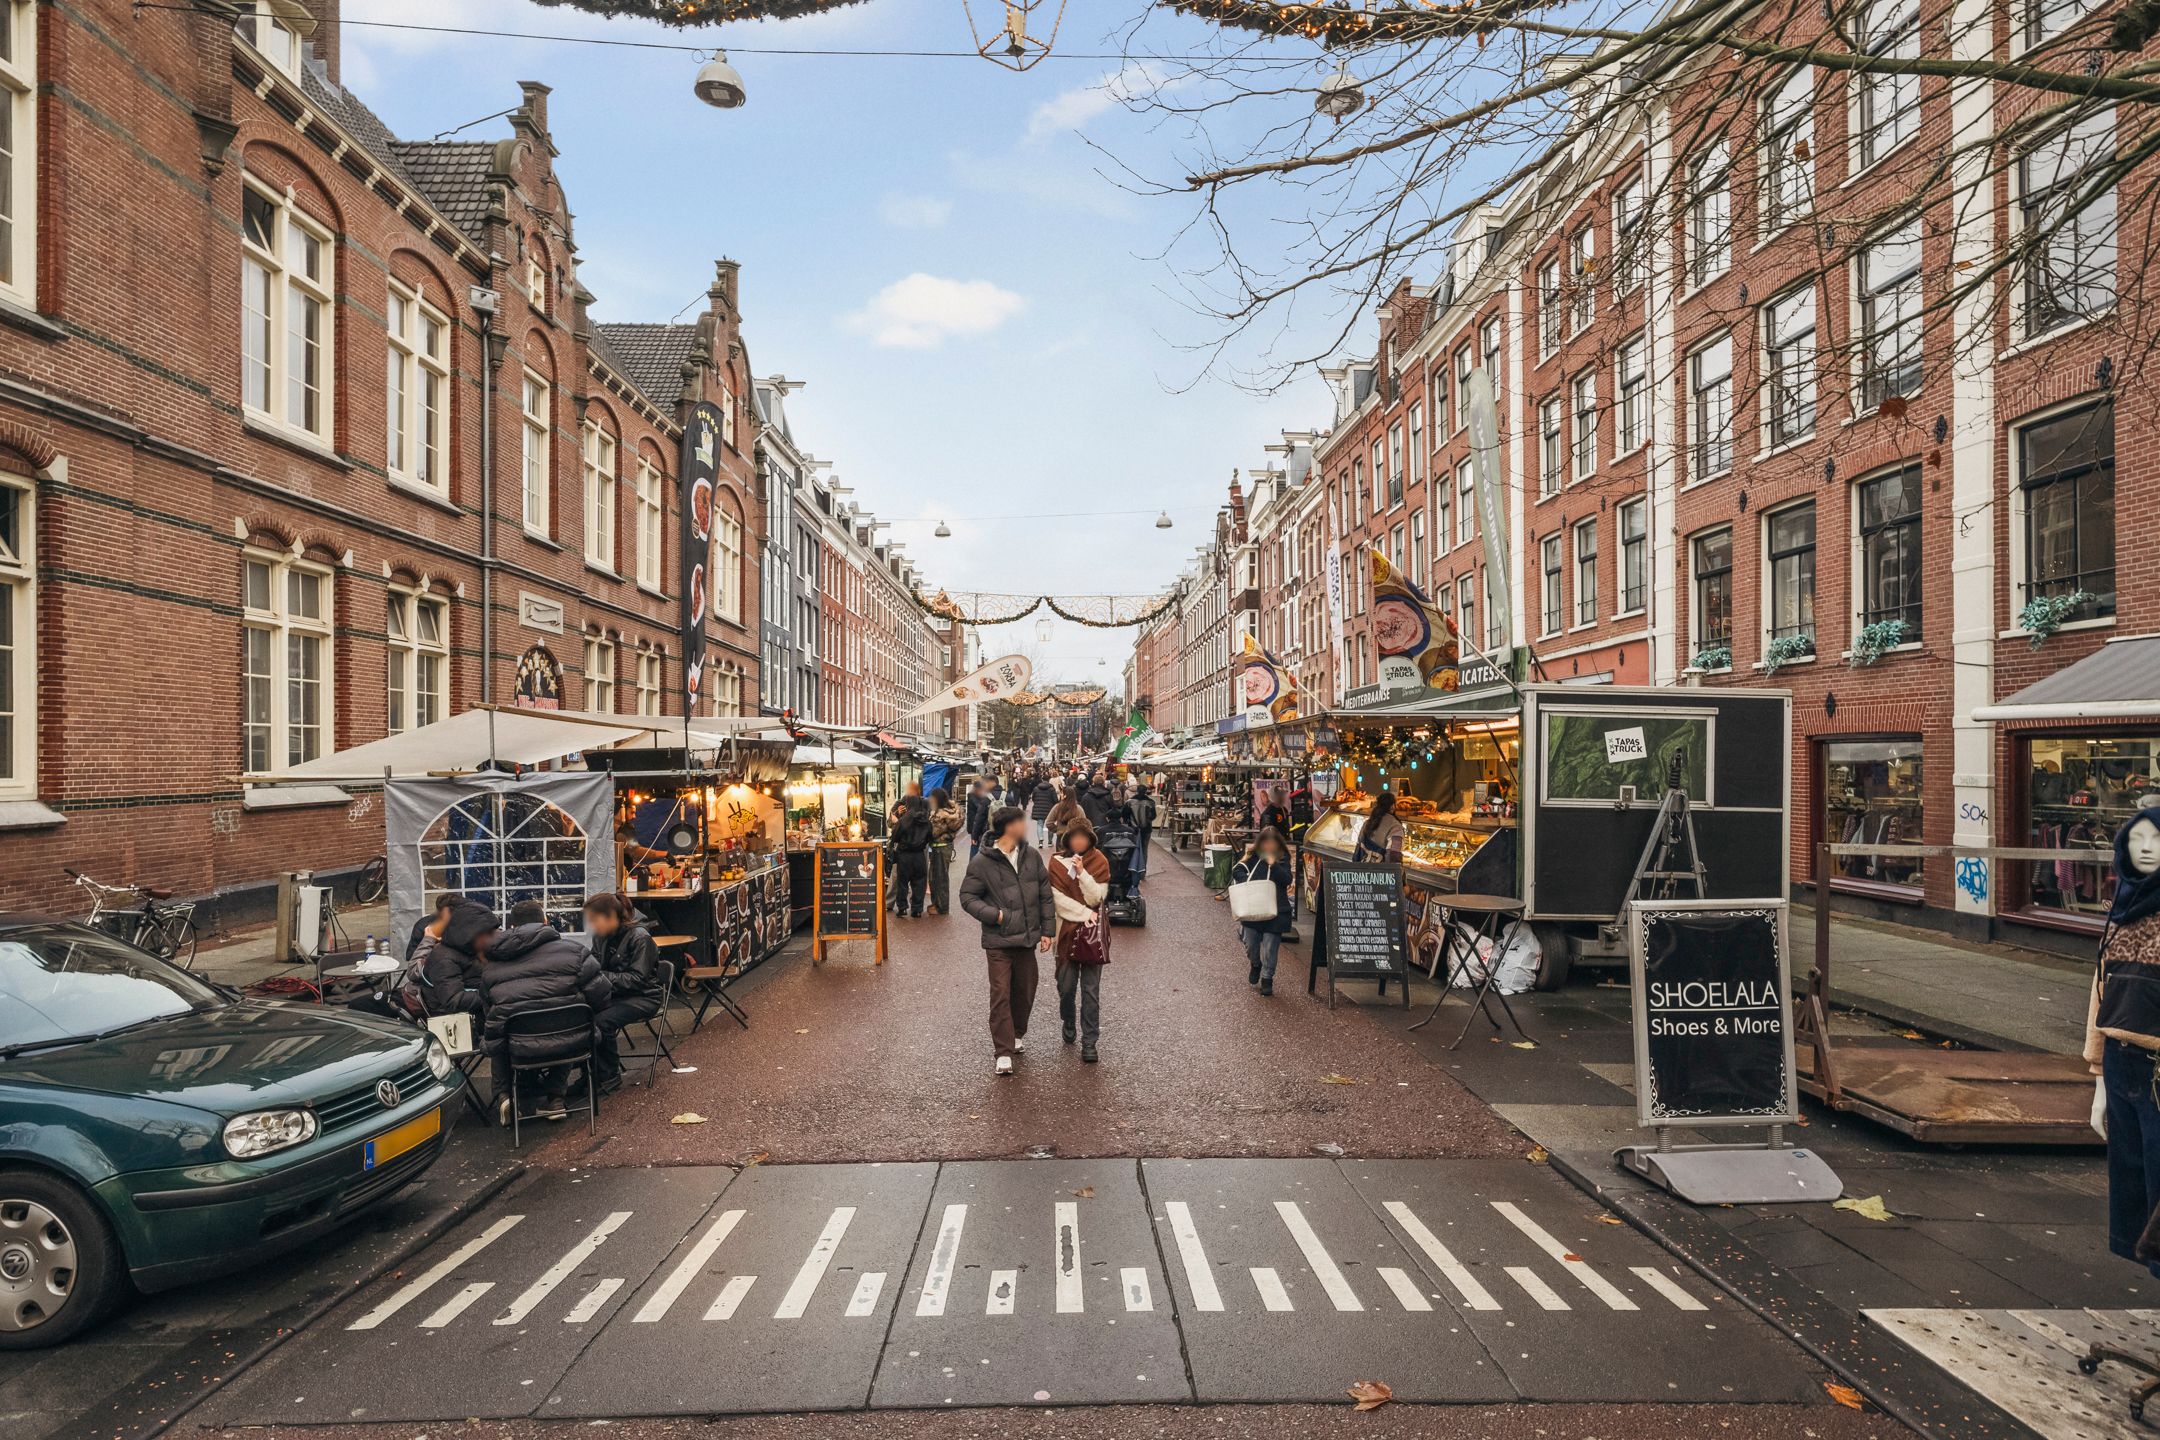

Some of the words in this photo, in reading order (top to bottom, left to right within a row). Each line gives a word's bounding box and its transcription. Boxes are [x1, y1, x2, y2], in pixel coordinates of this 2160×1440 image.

[999, 663, 1017, 689] ZORBA
[1344, 688, 1391, 710] MEDITERRAANSE
[1614, 745, 1643, 753] TRUCK
[1615, 738, 1640, 746] TAPAS
[1650, 981, 1779, 1007] SHOELALA
[1651, 1018, 1709, 1036] Shoes
[1714, 1018, 1729, 1035] &
[1734, 1017, 1780, 1035] More
